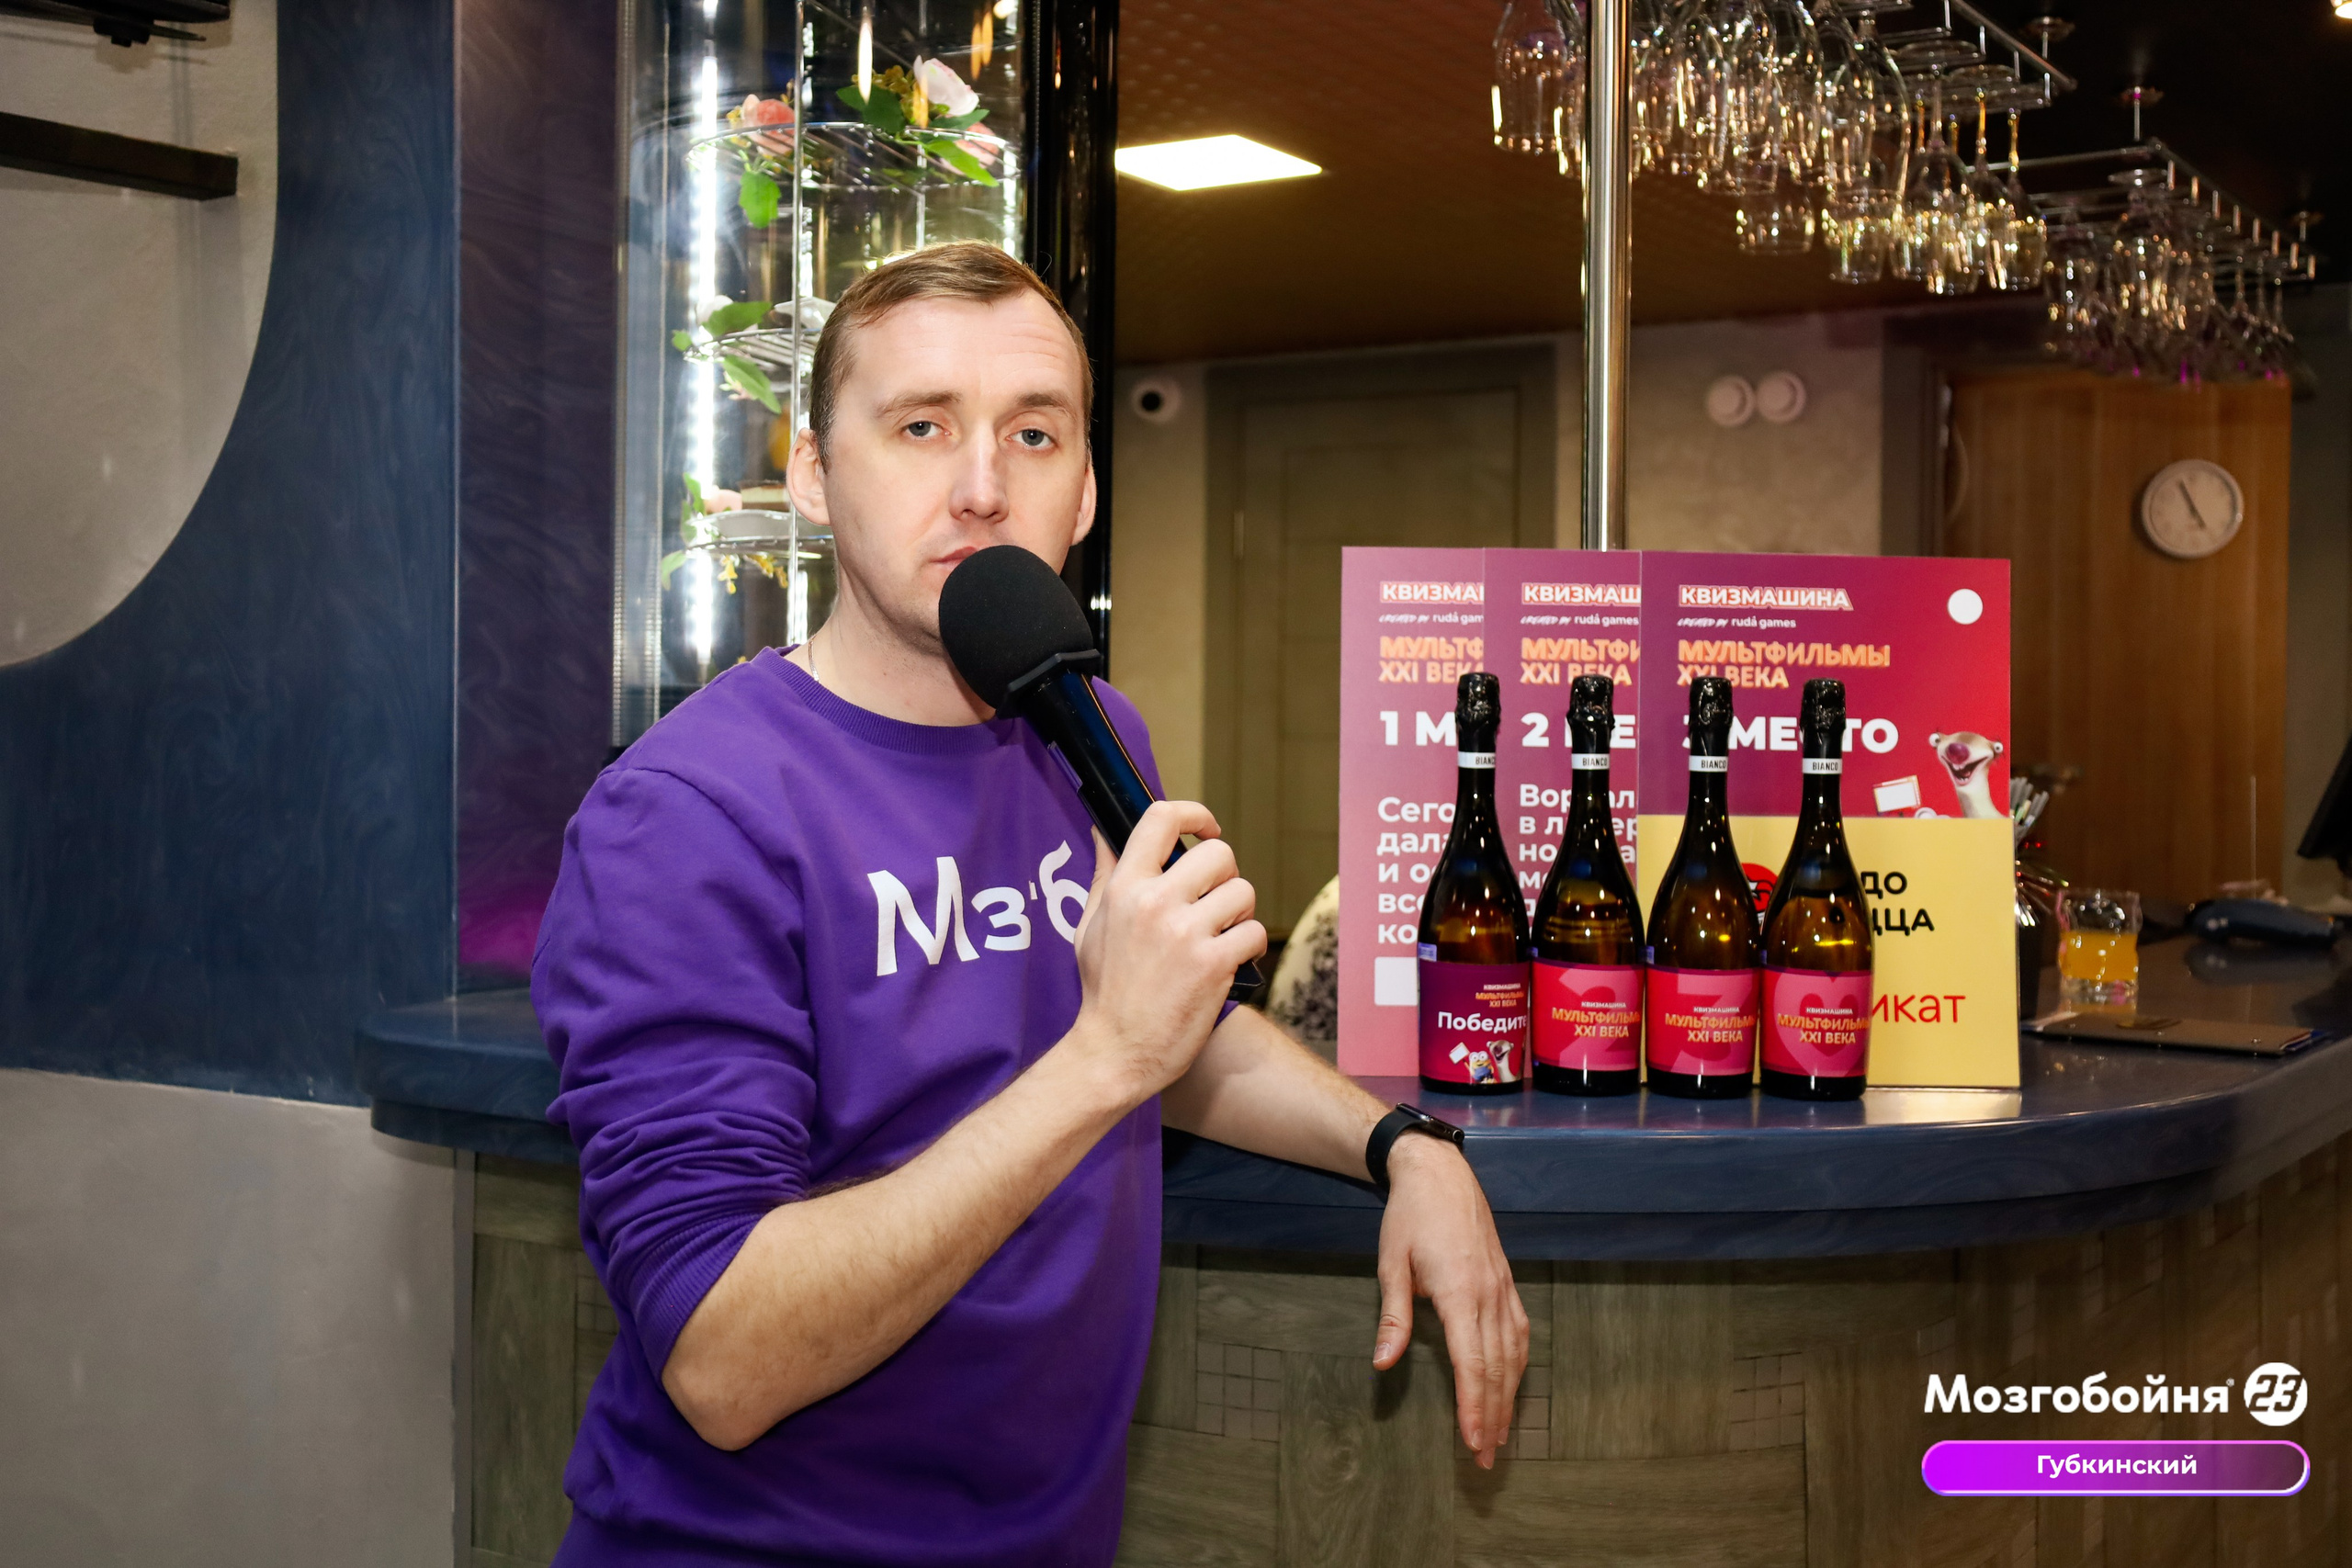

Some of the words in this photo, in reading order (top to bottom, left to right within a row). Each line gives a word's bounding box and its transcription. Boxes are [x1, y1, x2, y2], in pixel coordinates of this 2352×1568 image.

[1679, 585, 1852, 610] КВИЗМАШИНА
[1601, 616, 1640, 627] games
[1759, 618, 1796, 629] games
[1678, 640, 1891, 668] МУЛЬТФИЛЬМЫ
[1724, 666, 1789, 688] ВЕКА
[1380, 711, 1398, 745] 1
[1521, 712, 1549, 747] 2
[1731, 716, 1898, 753] МЕТО
[1582, 757, 1608, 767] BIANCO
[1701, 759, 1727, 769] BIANCO
[1812, 761, 1839, 771] BIANCO
[1379, 863, 1398, 883] и
[1806, 1007, 1853, 1015] КВИЗМАШИНА
[1600, 1025, 1629, 1038] ВЕКА
[1713, 1031, 1744, 1043] ВЕКА
[1825, 1032, 1856, 1044] ВЕКА
